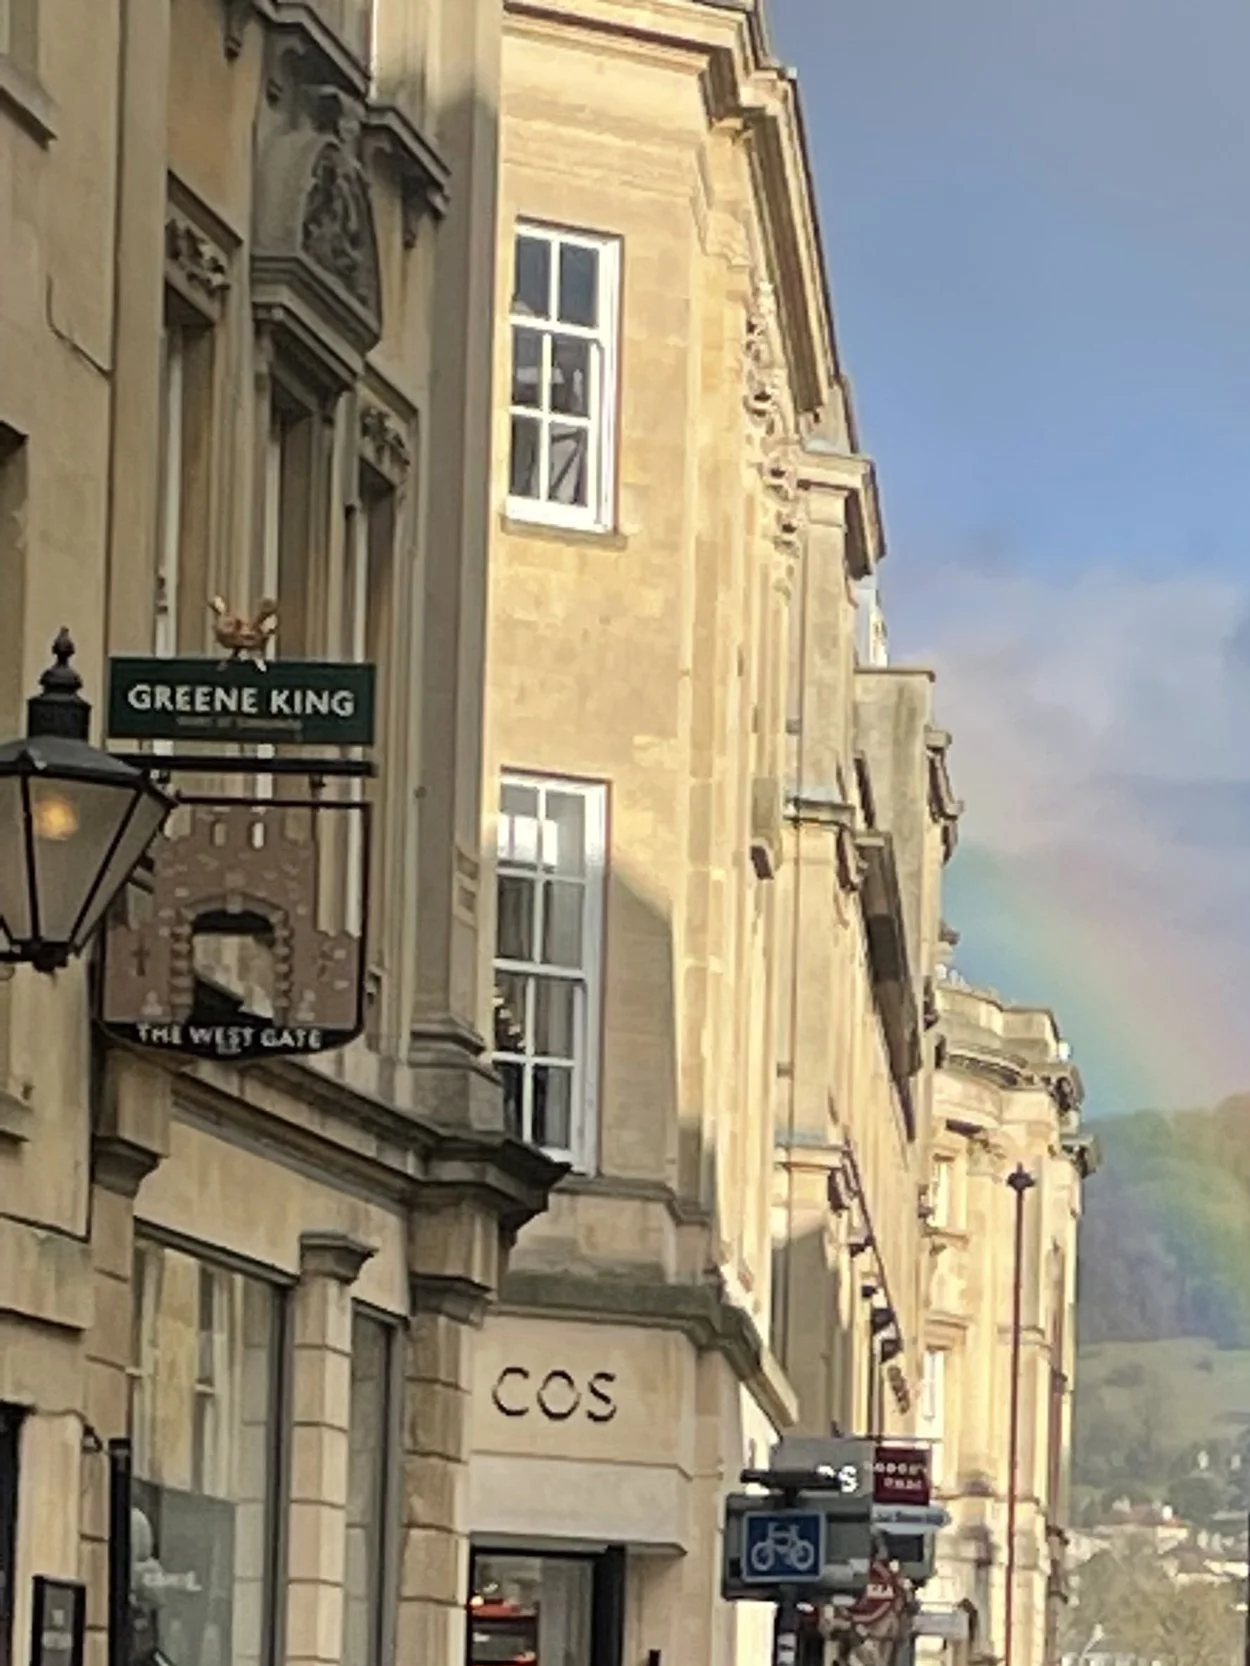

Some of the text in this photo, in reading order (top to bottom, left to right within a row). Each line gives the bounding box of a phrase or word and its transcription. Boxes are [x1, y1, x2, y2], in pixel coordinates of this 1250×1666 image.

[127, 684, 355, 717] GREENE KING
[136, 1023, 322, 1049] THE WEST GATE
[491, 1366, 618, 1423] COS
